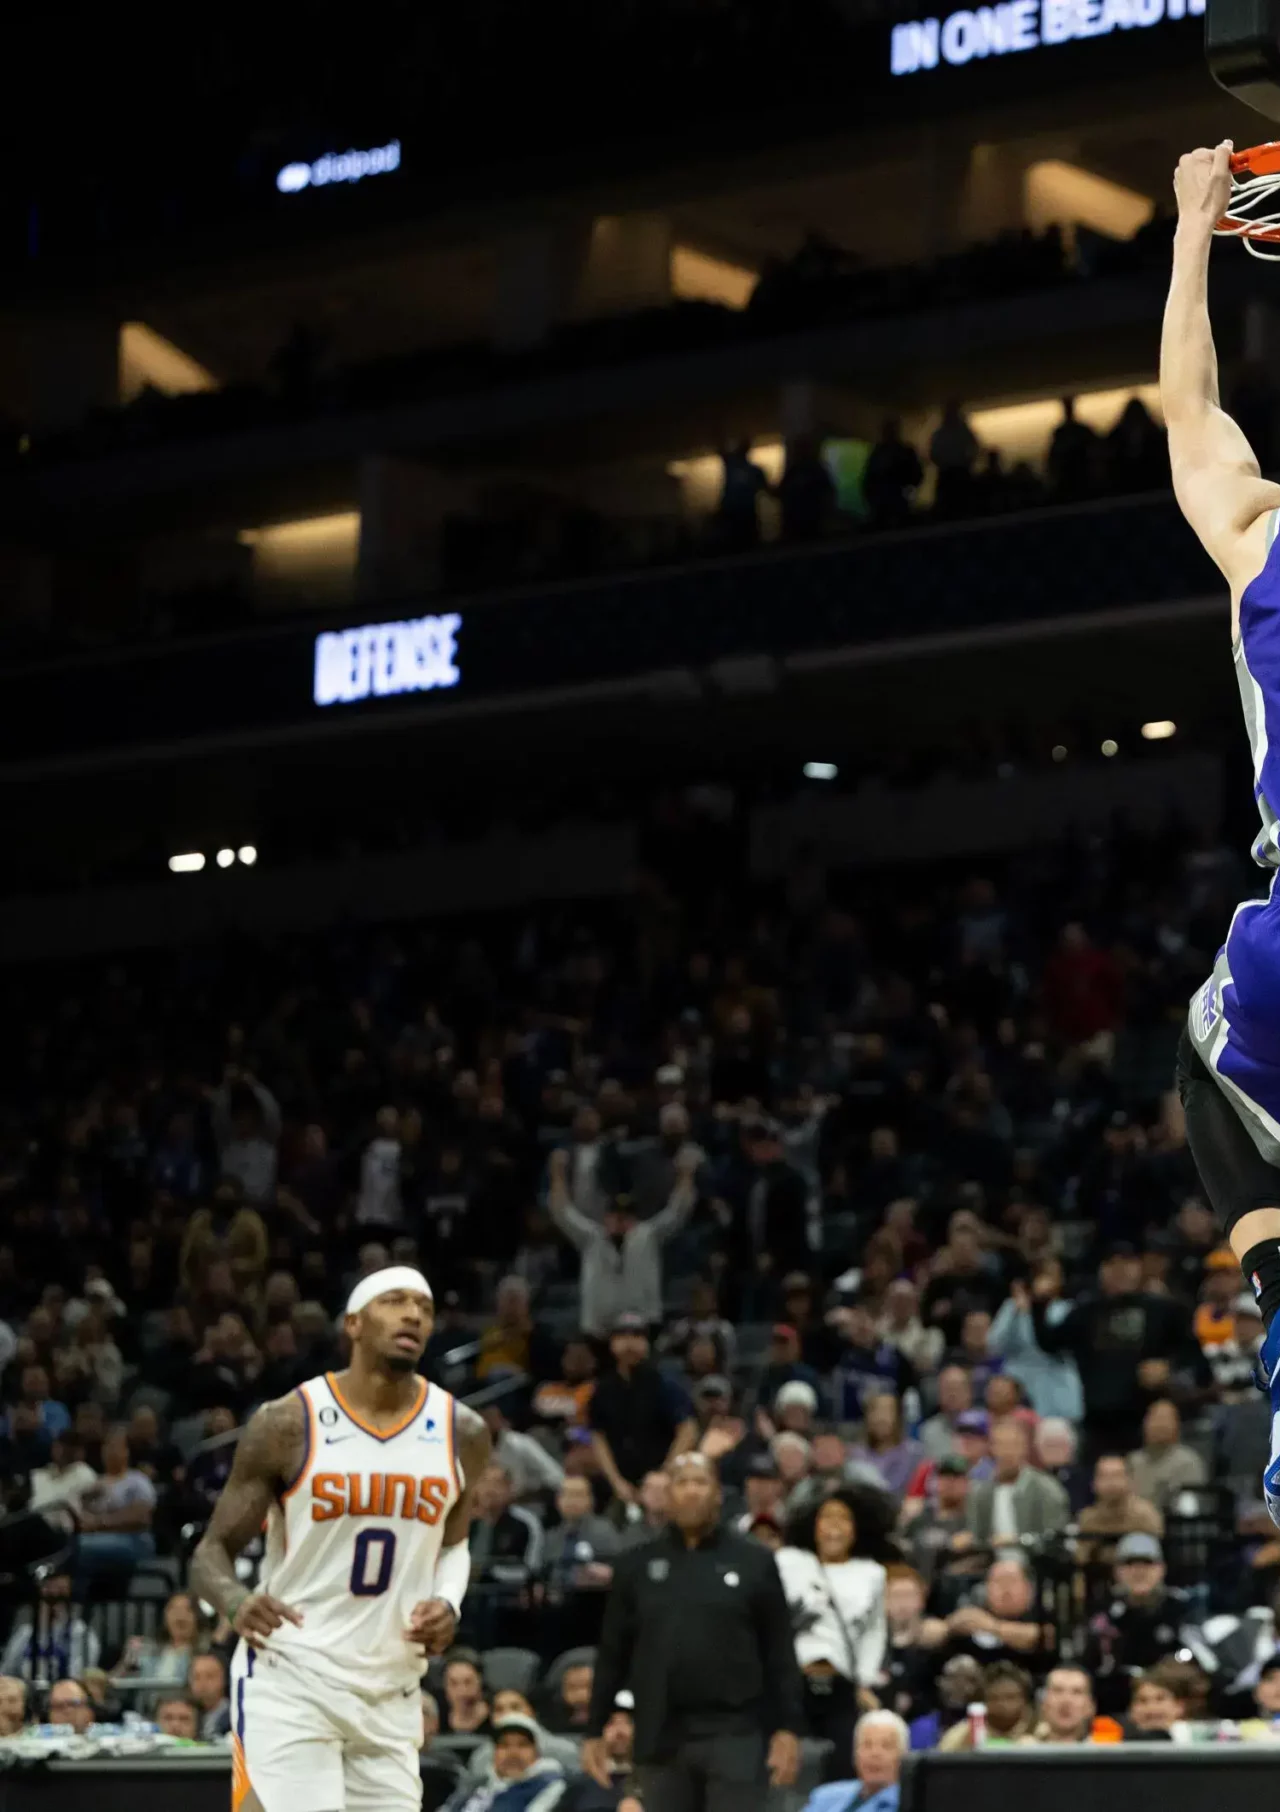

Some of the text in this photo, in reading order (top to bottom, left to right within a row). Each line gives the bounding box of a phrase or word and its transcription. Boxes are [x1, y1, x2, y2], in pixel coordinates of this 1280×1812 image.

[891, 17, 940, 76] IN
[941, 0, 1041, 65] ONE
[314, 612, 463, 707] DEFENSE
[350, 1528, 397, 1597] 0
